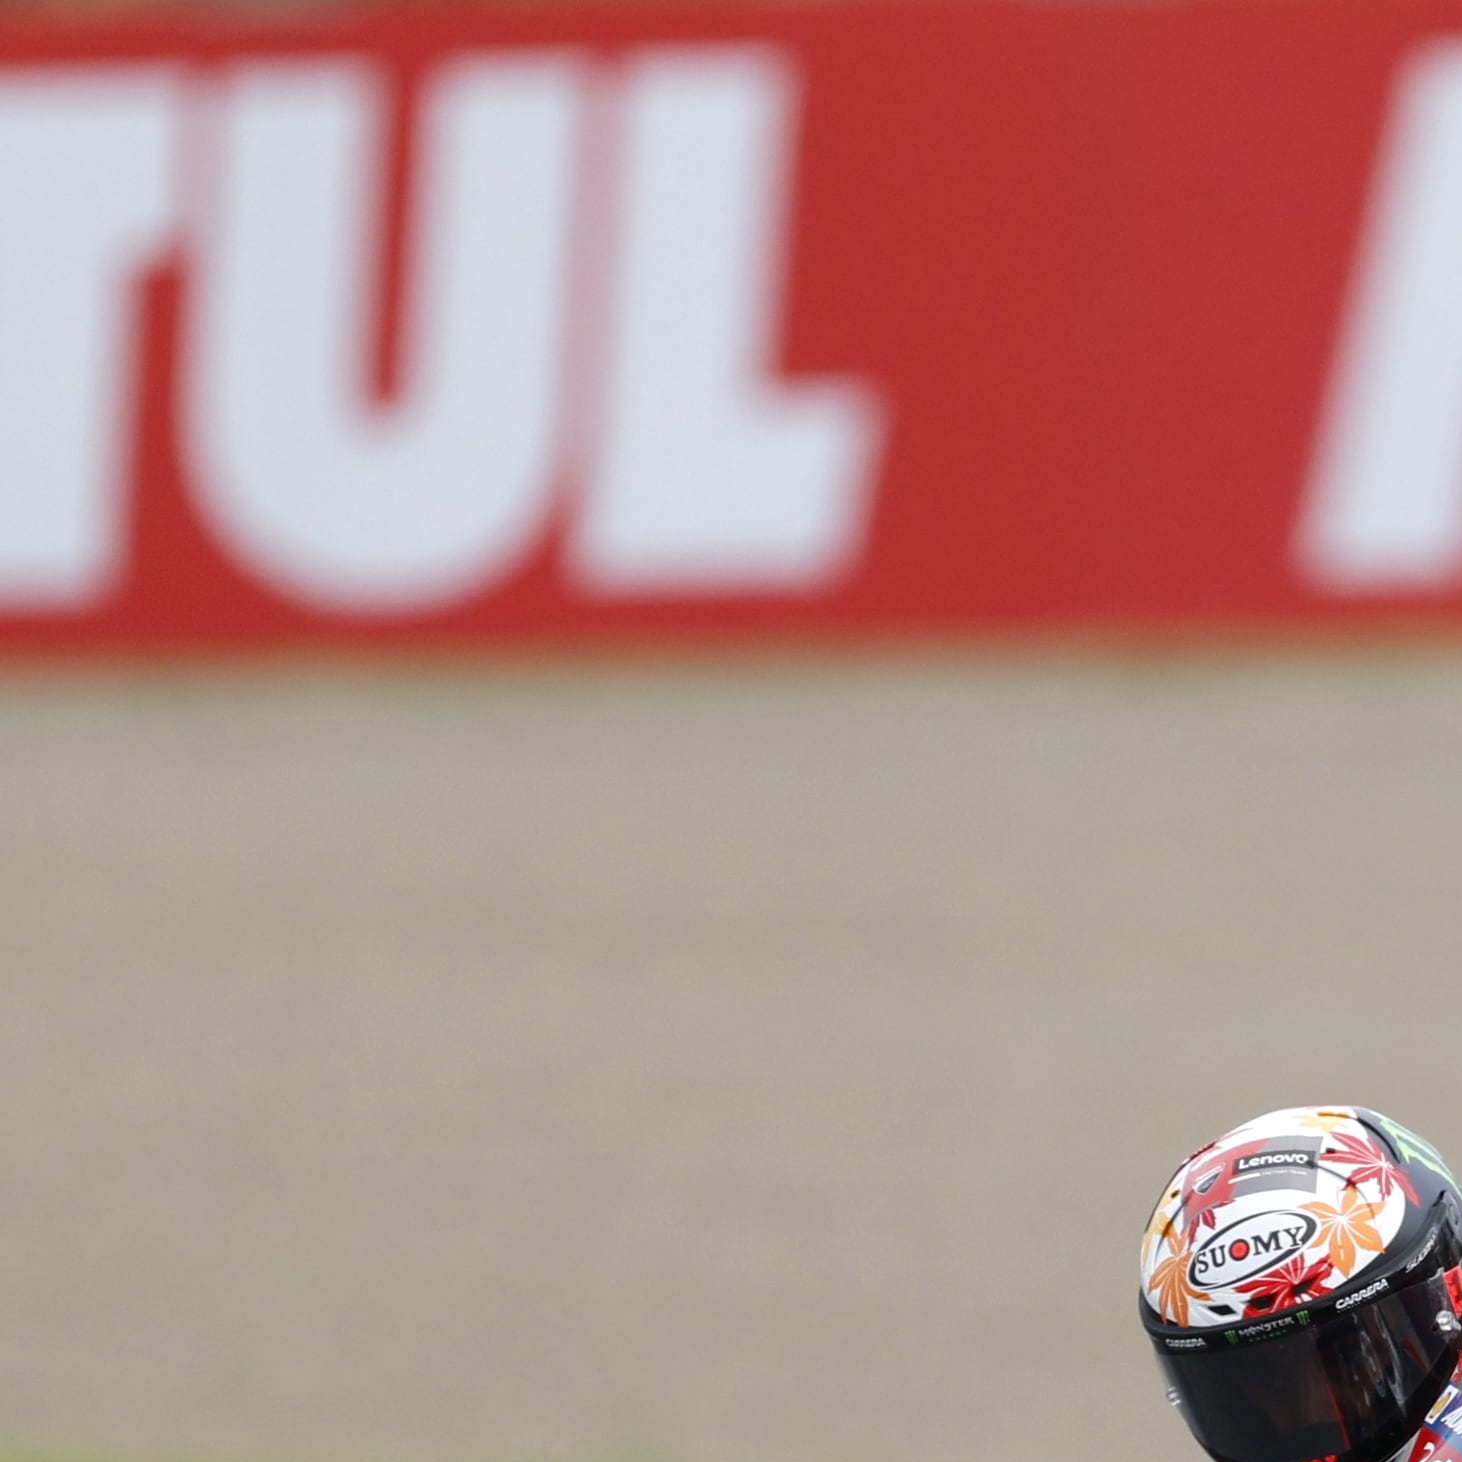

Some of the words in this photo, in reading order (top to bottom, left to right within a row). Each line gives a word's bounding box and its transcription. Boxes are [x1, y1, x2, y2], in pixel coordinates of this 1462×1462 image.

[1237, 1152, 1309, 1170] Lenovo
[1195, 1224, 1305, 1275] SUOMY
[1335, 1278, 1389, 1310] CARRERA
